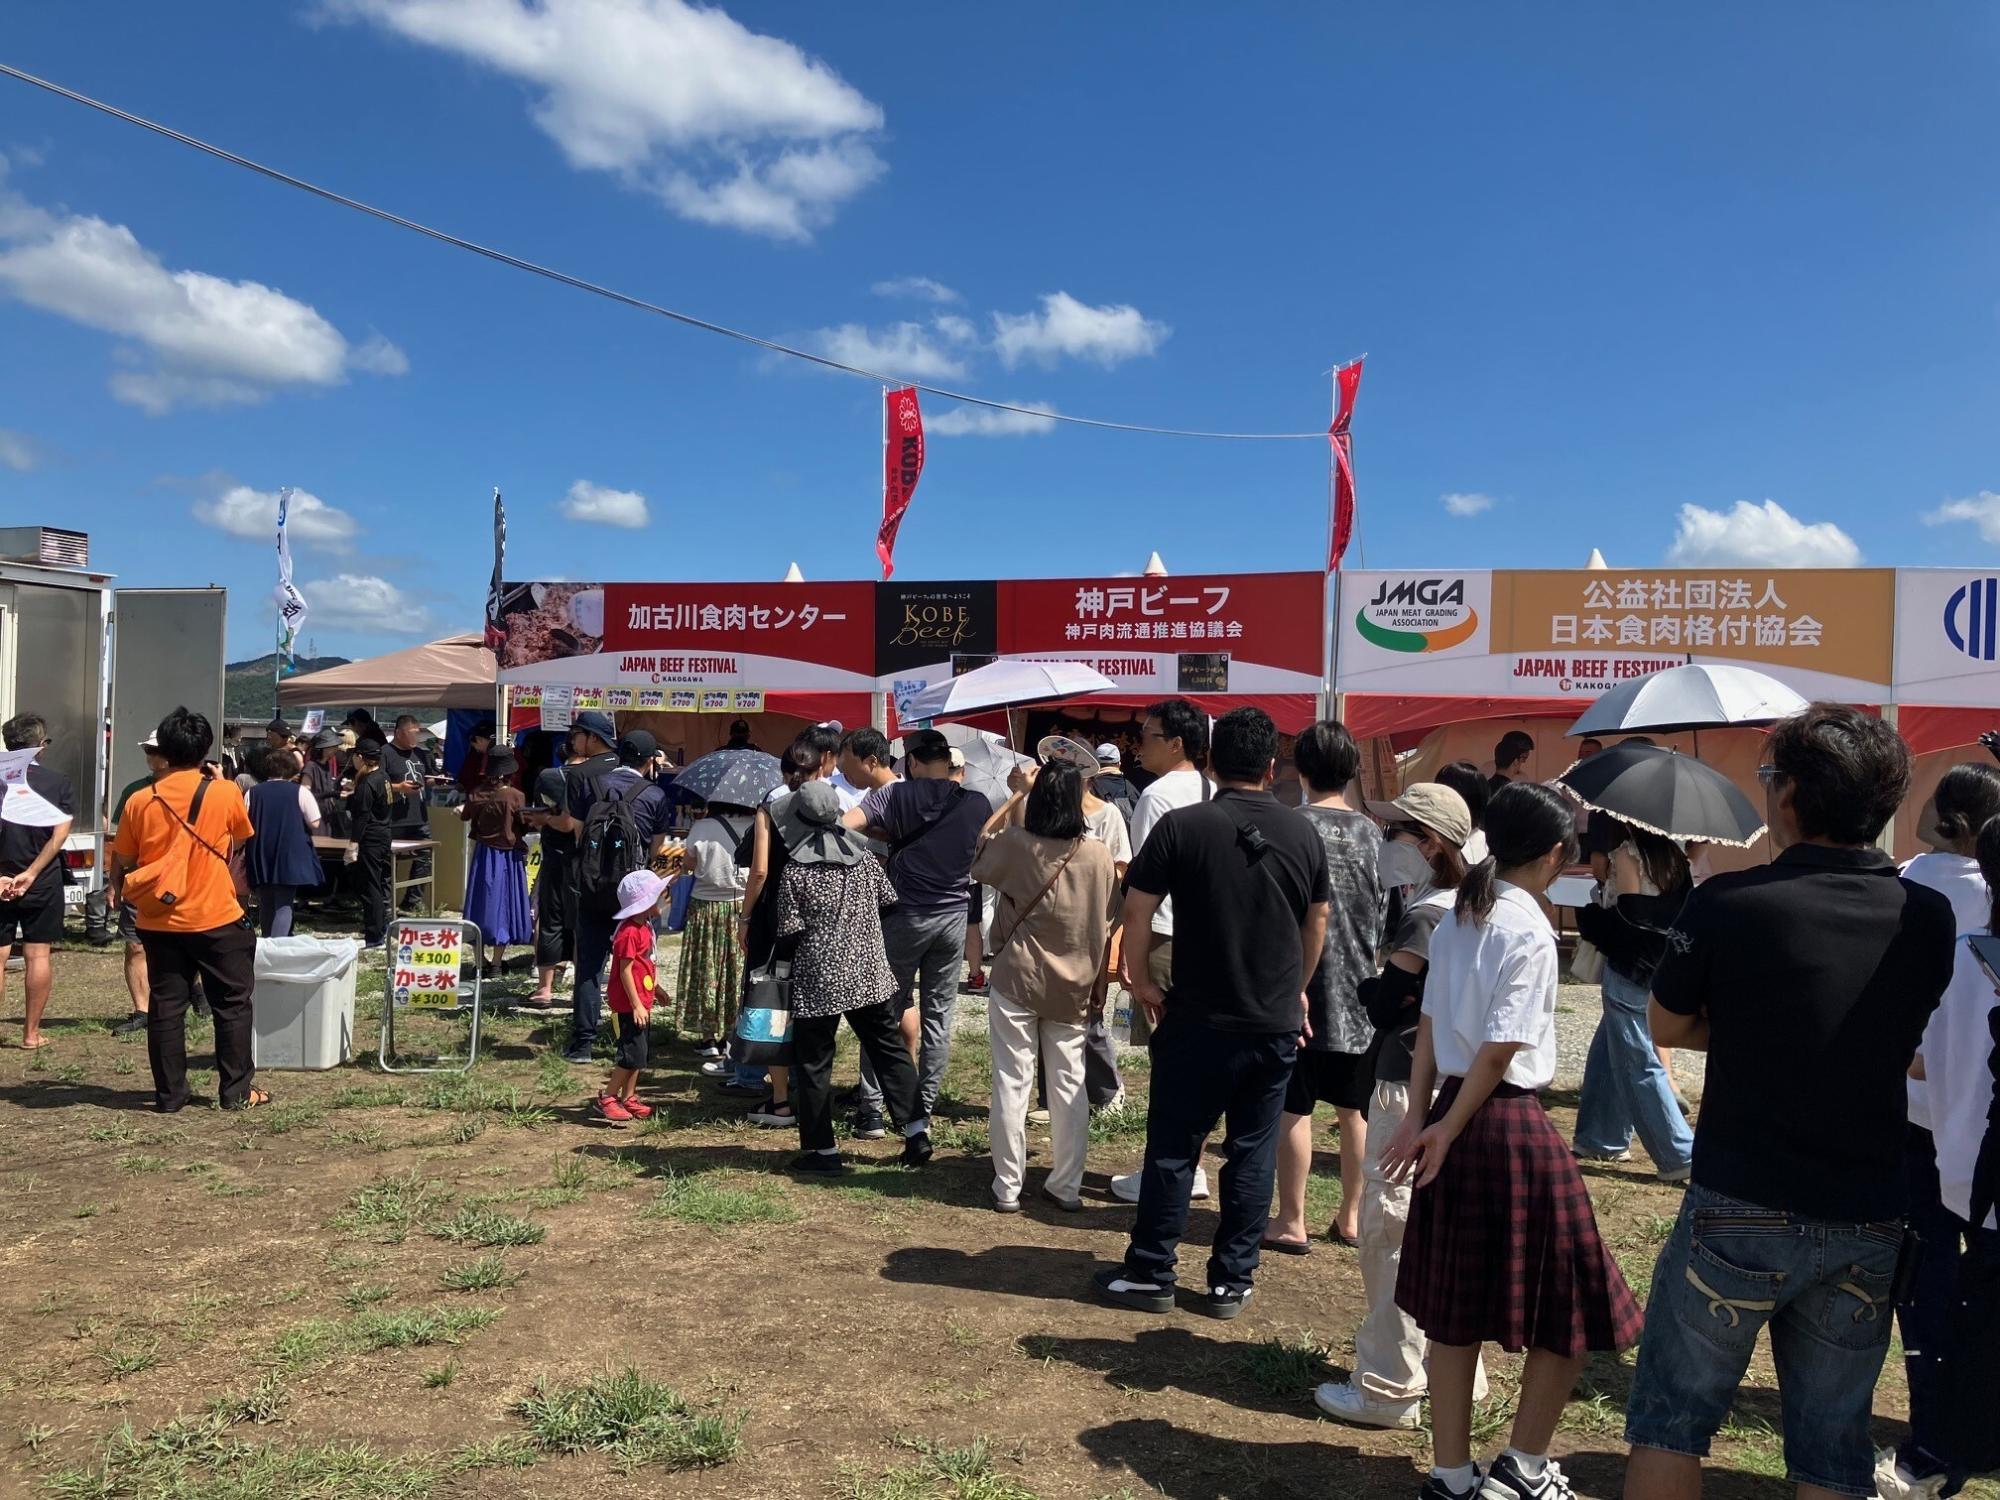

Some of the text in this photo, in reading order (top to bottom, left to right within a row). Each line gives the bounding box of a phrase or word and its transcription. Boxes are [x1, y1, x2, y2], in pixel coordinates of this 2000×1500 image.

[1371, 579, 1464, 606] JMGA
[1583, 579, 1787, 610] 公益社団法人
[1075, 586, 1232, 619] 神戸ビーフ
[628, 603, 847, 631] 加古川食肉センター
[904, 604, 968, 622] KOBE
[1375, 609, 1458, 617] JAPAN MEAT GRADING
[890, 617, 976, 646] Beef
[1064, 620, 1244, 641] 神戸肉流通推進協議会
[1392, 619, 1439, 627] ASSOCIATION
[1552, 614, 1823, 647] 日本食肉格付協会
[620, 656, 737, 674] JAPAN BEEF FESTIVAL
[1097, 658, 1156, 676] FESTIVAL
[1513, 659, 1566, 678] JAPAN
[1572, 660, 1608, 678] BEEF
[662, 675, 704, 683] KAKOGAWA
[514, 685, 542, 696] かき氷
[573, 686, 603, 699] かき氷
[400, 927, 459, 949] かき氷
[414, 953, 451, 964] ¥300
[396, 969, 457, 991] かき氷
[411, 993, 448, 1005] ¥300
